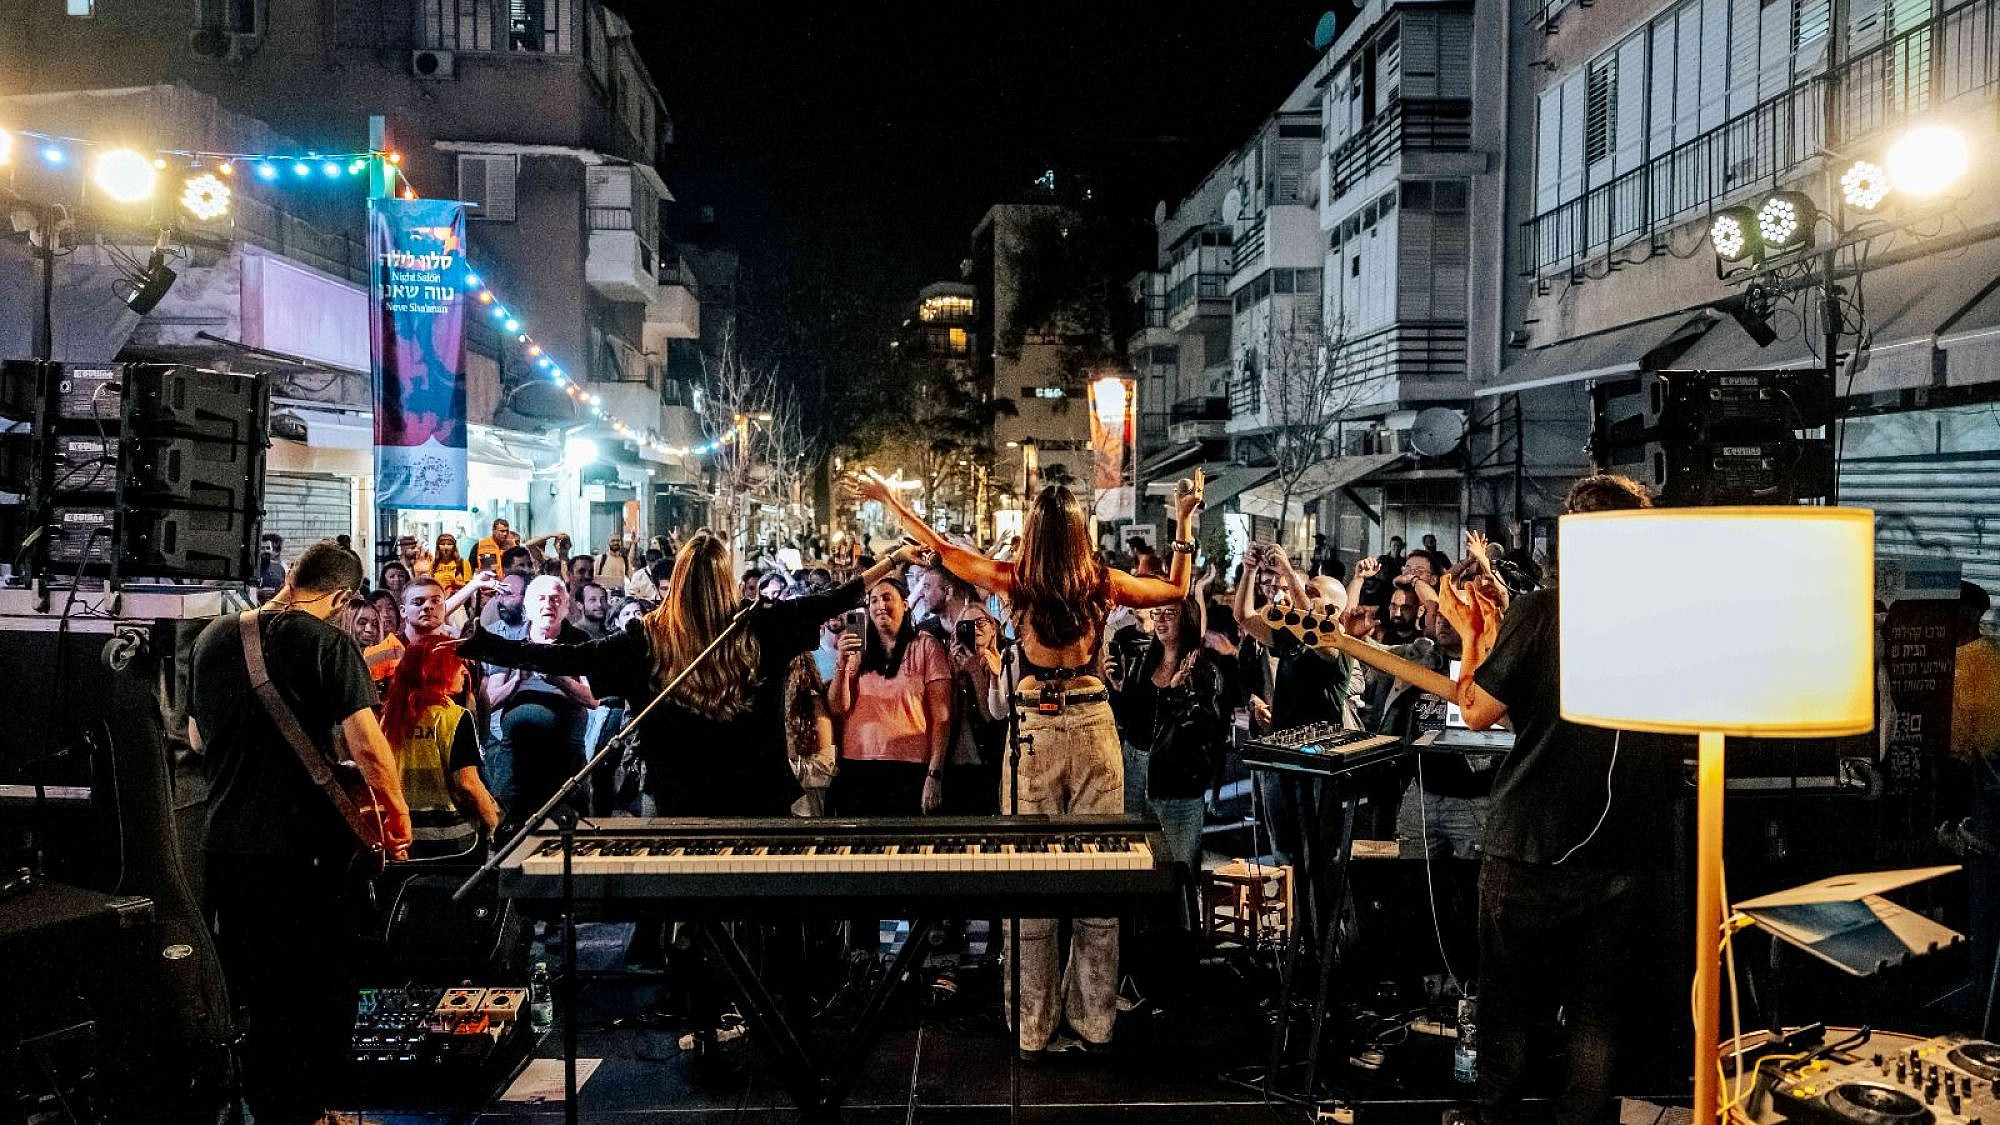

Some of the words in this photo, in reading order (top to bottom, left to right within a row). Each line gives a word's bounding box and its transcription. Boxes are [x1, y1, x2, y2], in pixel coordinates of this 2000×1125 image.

[420, 250, 453, 271] סלון
[392, 272, 415, 283] Night
[424, 286, 455, 301] נווה
